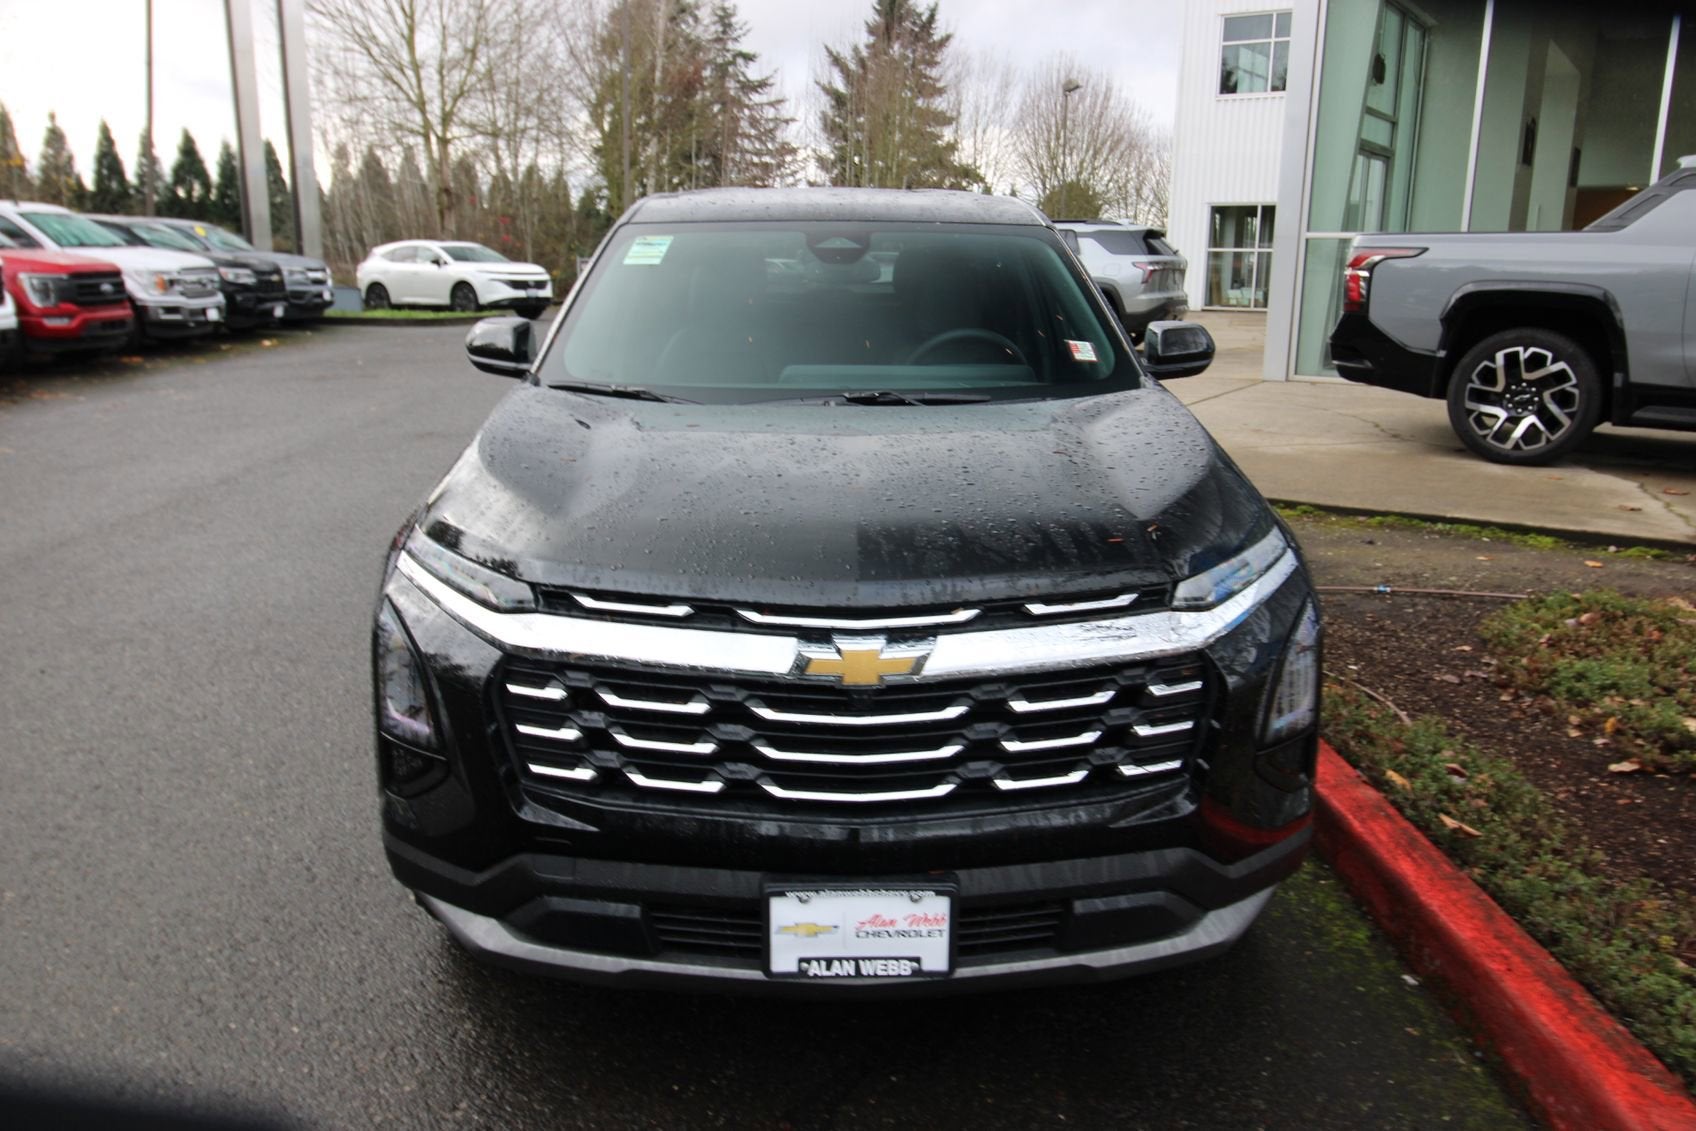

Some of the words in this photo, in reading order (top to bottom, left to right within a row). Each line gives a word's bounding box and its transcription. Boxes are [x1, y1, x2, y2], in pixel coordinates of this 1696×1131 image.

[855, 913, 897, 930] Alan
[855, 929, 946, 938] CHEVROLET
[807, 959, 856, 976] ALAN
[858, 959, 913, 976] WEBB
